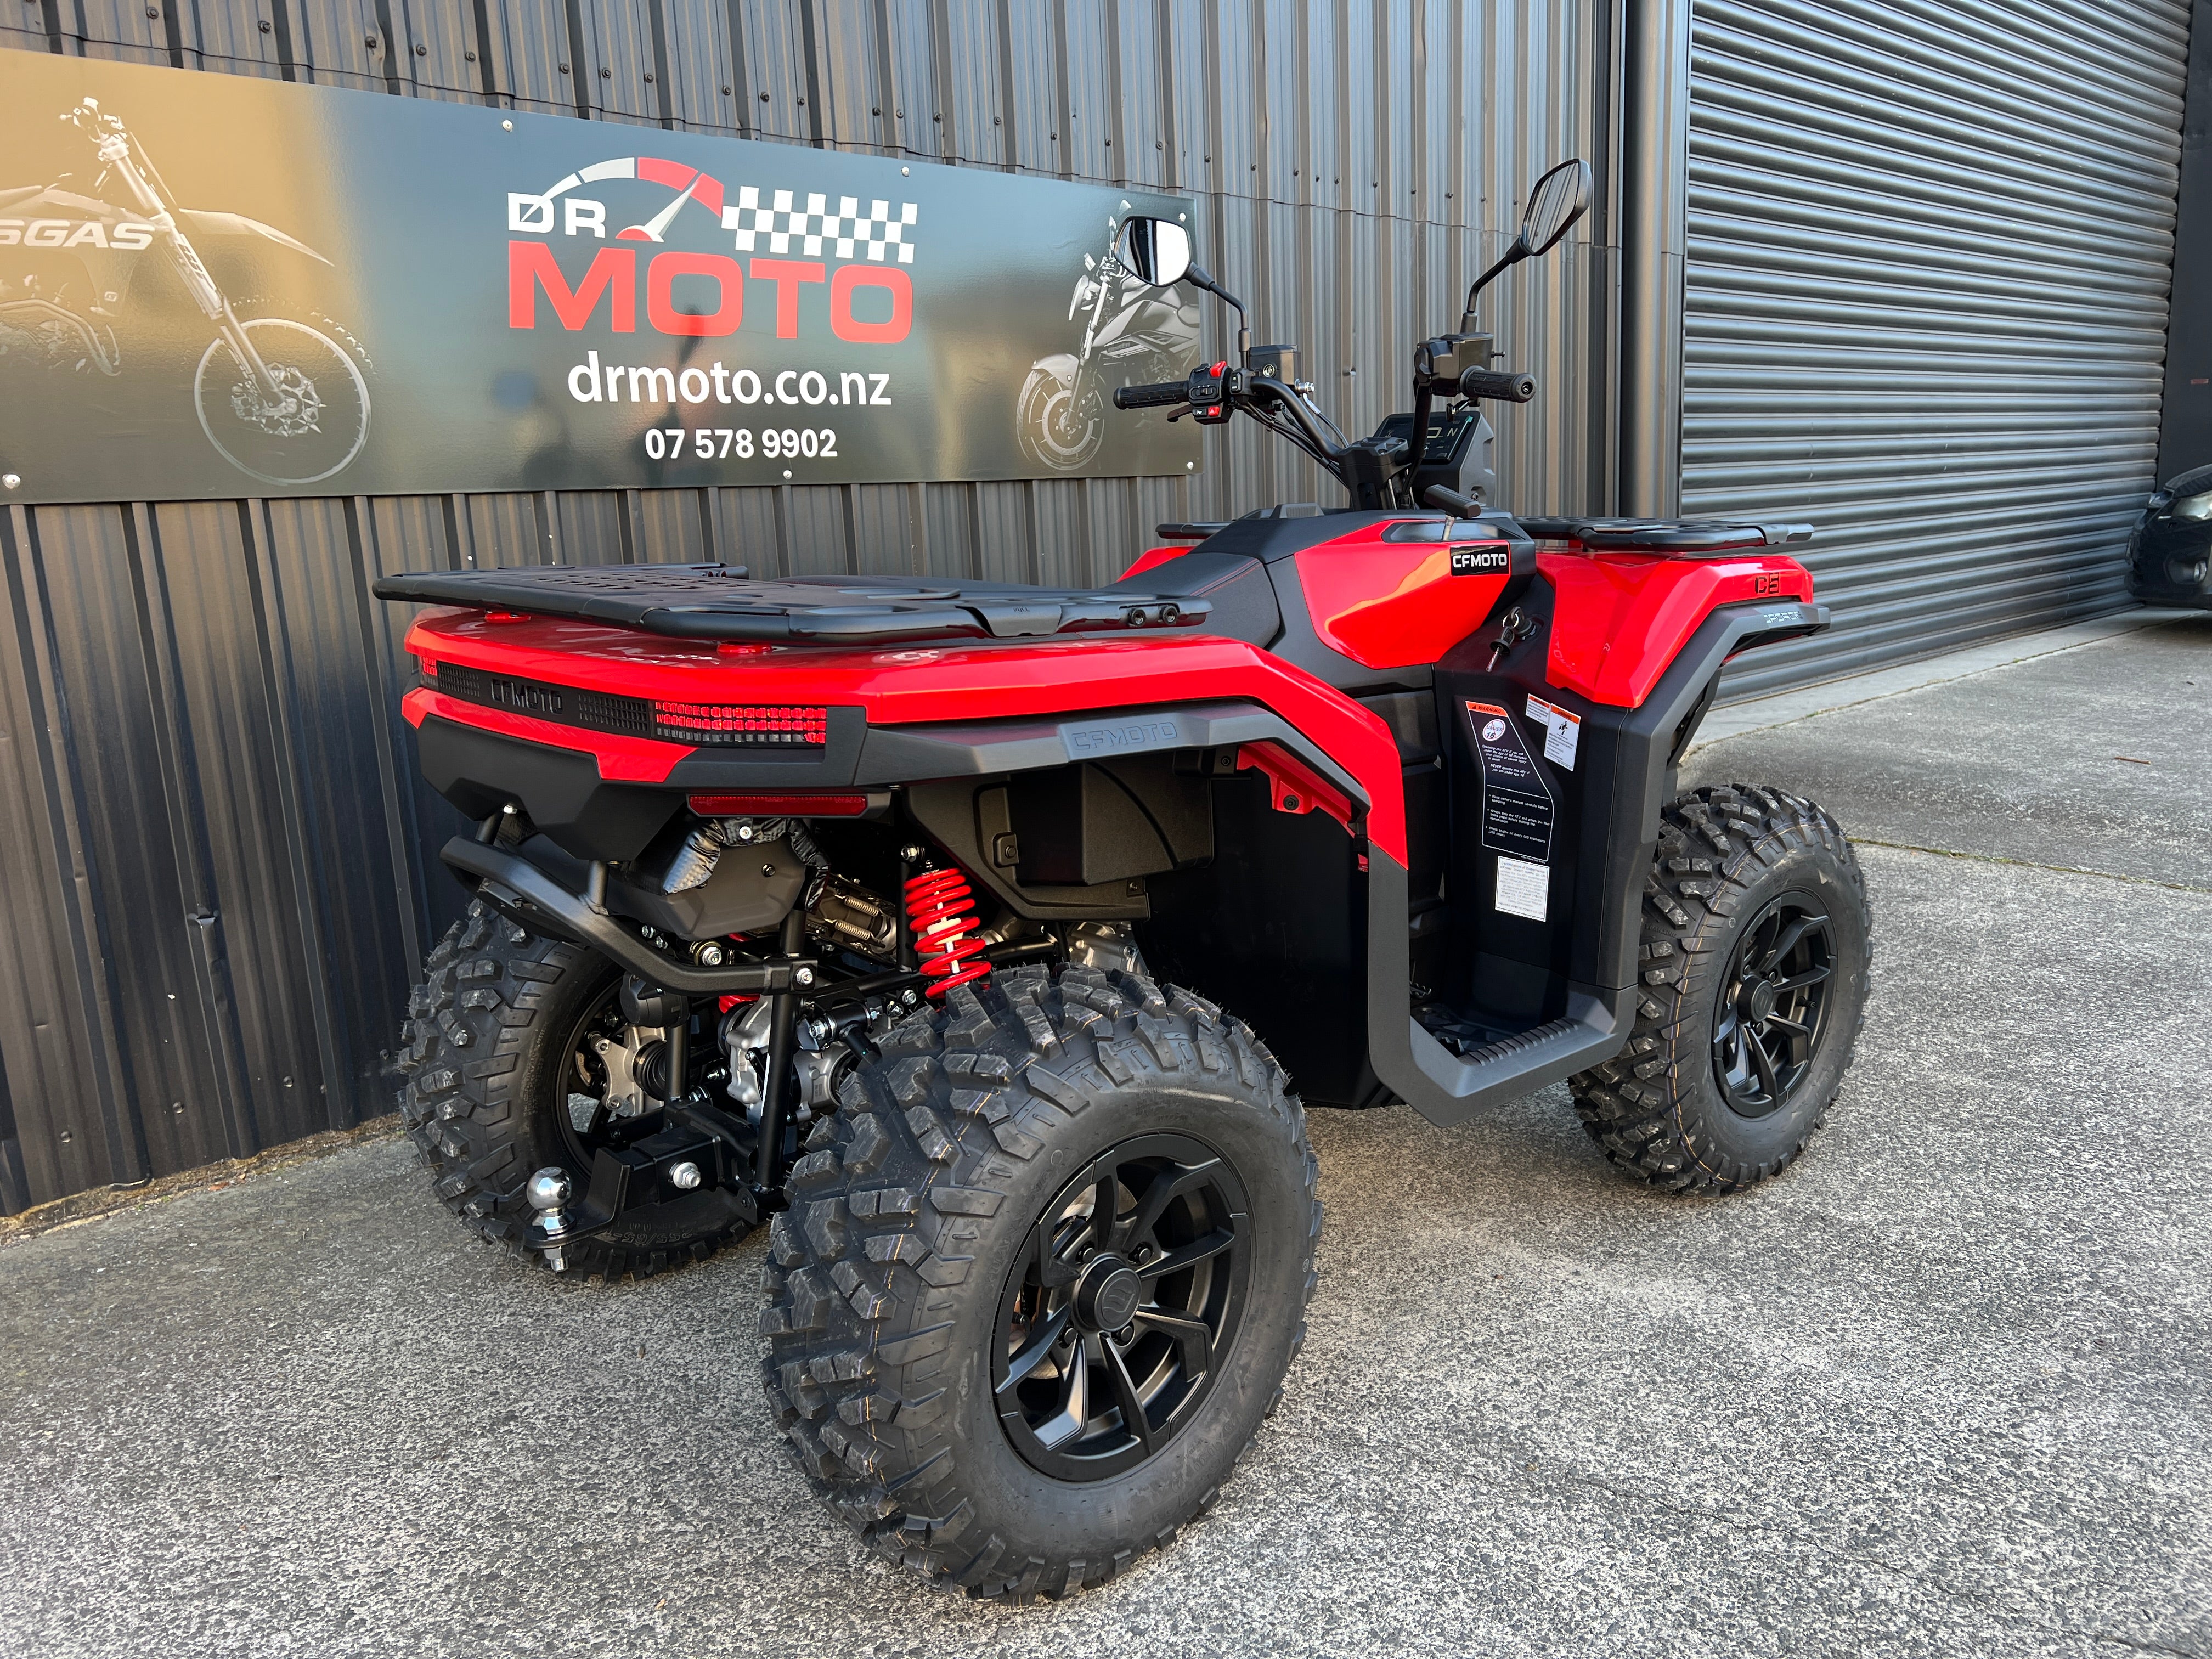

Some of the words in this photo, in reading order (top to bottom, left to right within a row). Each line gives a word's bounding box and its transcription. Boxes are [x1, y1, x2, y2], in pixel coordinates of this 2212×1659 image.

[507, 191, 606, 238] DR
[509, 240, 913, 344] MOTO
[567, 351, 893, 405] drmoto.co.nz
[645, 429, 685, 460] 07
[695, 429, 755, 459] 578
[761, 428, 838, 458] 9902
[1453, 554, 1508, 568] CFMOTO
[490, 679, 563, 715] CFMOTO
[1478, 706, 1502, 714] WARNING
[1071, 722, 1177, 751] CFMOTO
